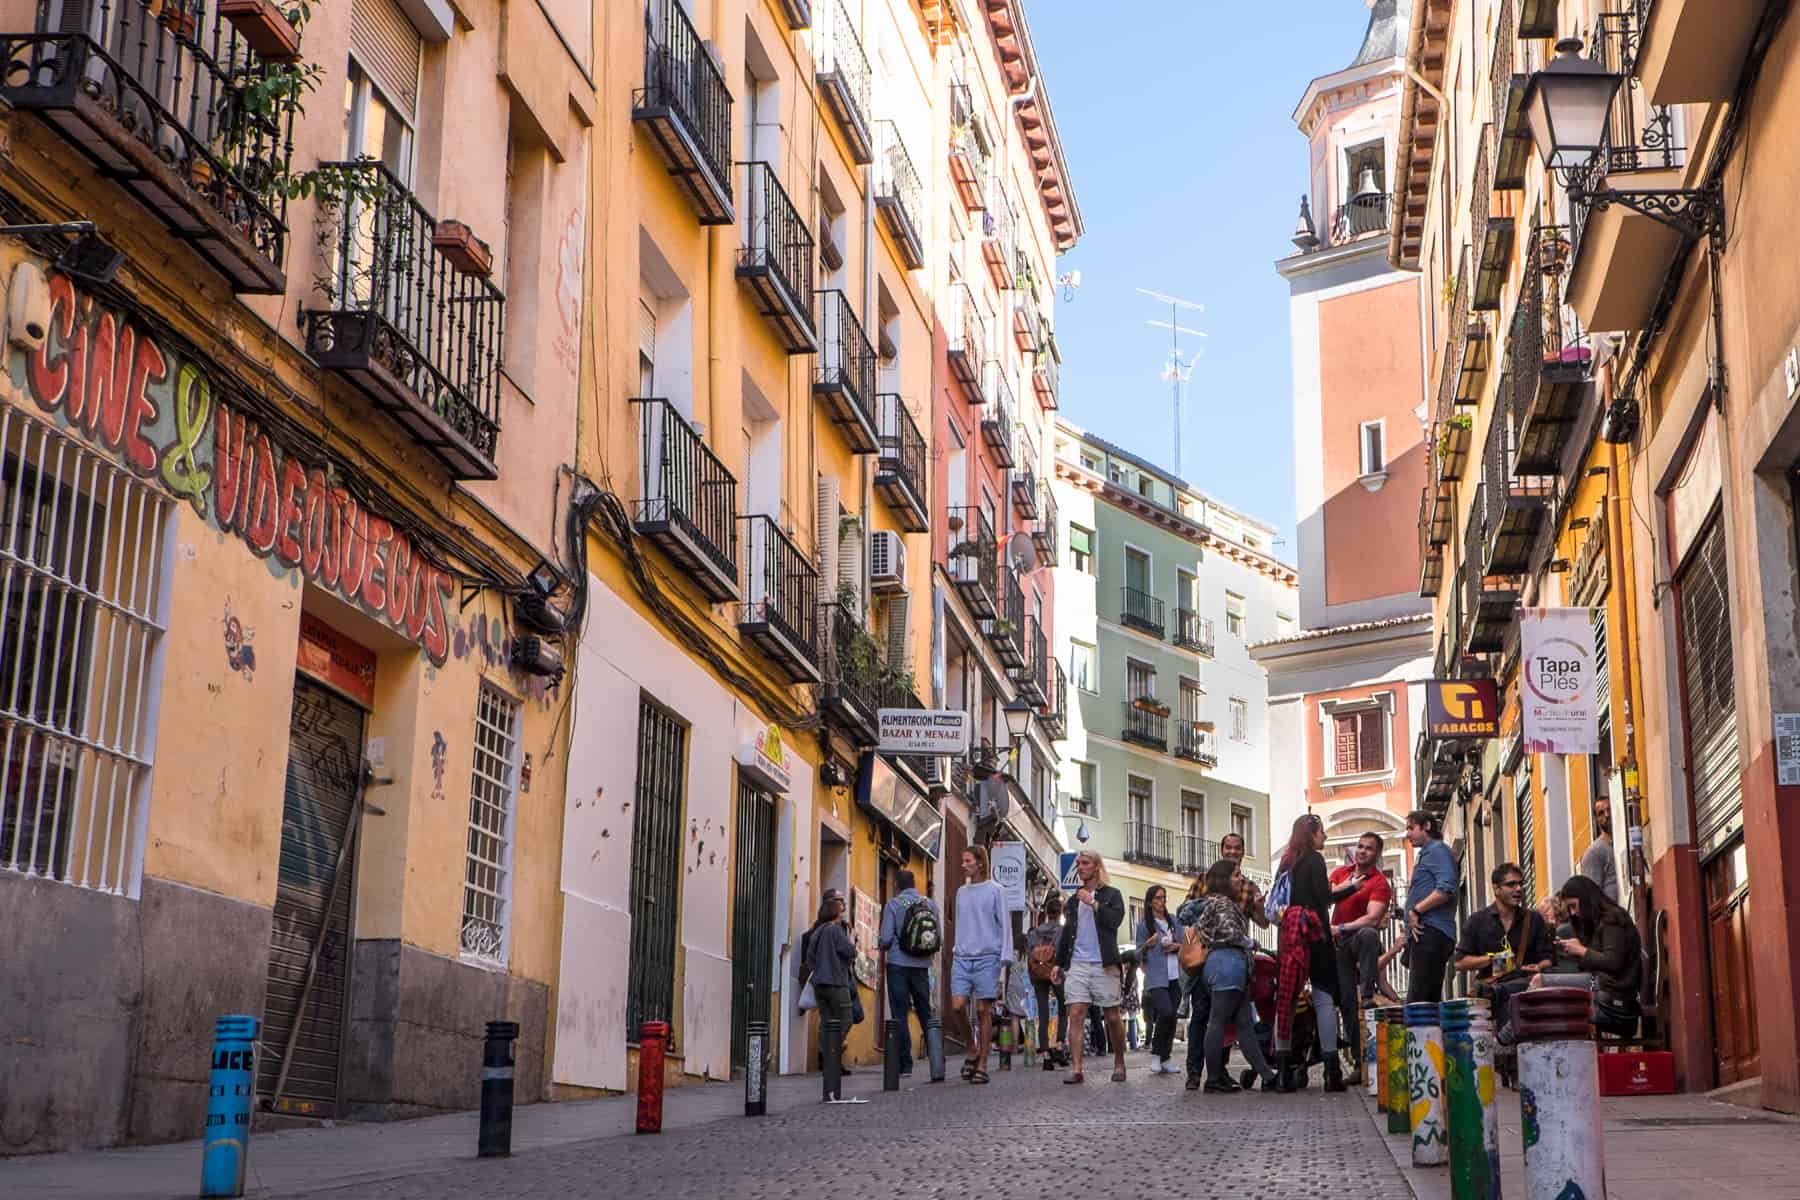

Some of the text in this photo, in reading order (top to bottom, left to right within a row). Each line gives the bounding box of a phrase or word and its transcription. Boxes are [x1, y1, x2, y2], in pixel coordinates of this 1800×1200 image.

[162, 362, 210, 510] &
[1536, 656, 1581, 676] Tapa
[1541, 672, 1579, 691] Piés
[881, 714, 933, 727] ALIMENTACION
[882, 728, 961, 740] BAZAR Y MENAJE
[1433, 721, 1494, 735] TABACOS
[998, 865, 1019, 874] Tapa
